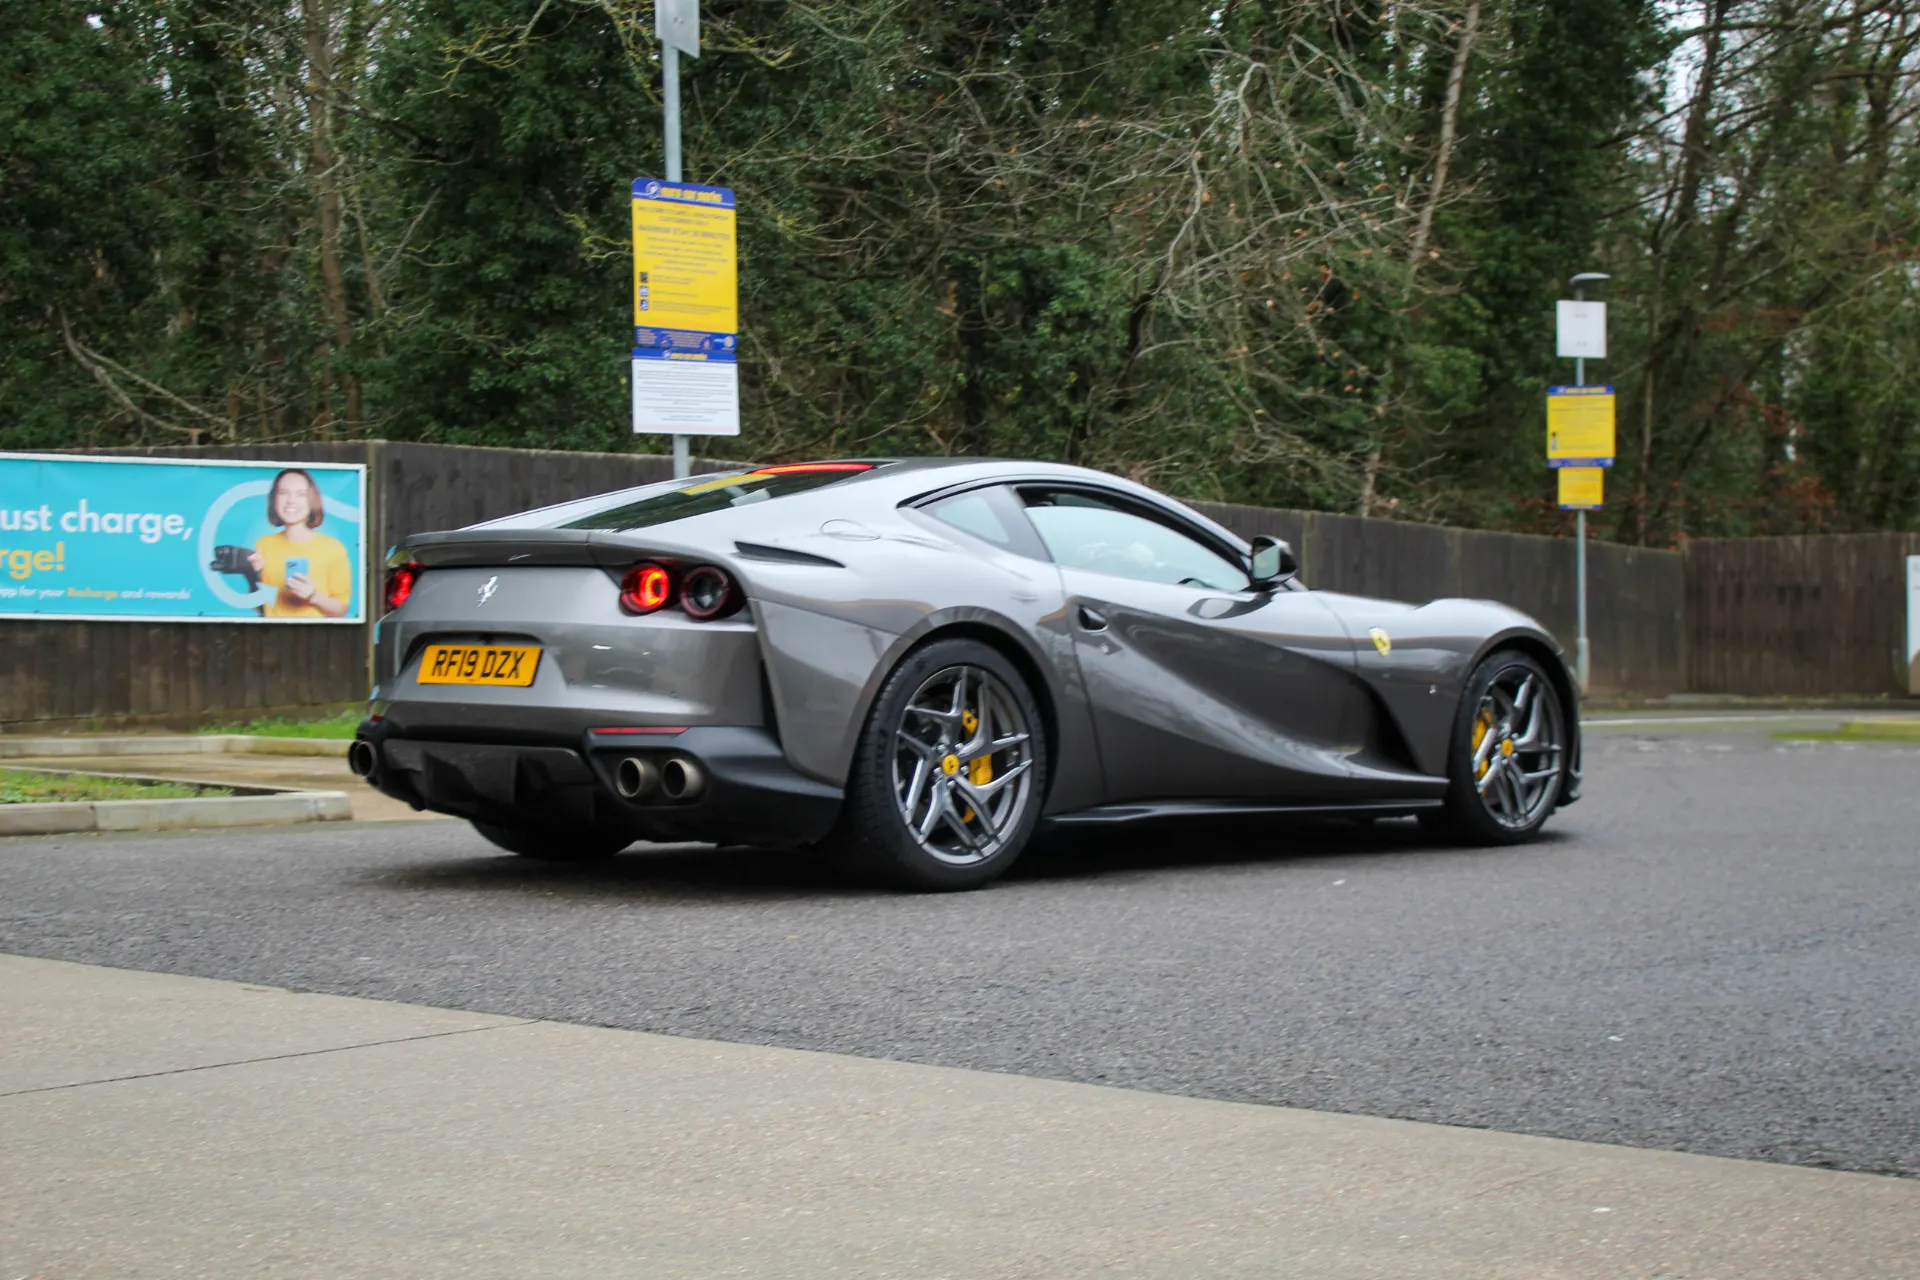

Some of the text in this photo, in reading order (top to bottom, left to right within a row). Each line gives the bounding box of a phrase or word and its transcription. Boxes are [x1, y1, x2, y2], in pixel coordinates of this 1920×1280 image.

[0, 498, 193, 544] ust charge,
[431, 649, 527, 679] RF19 DZX
